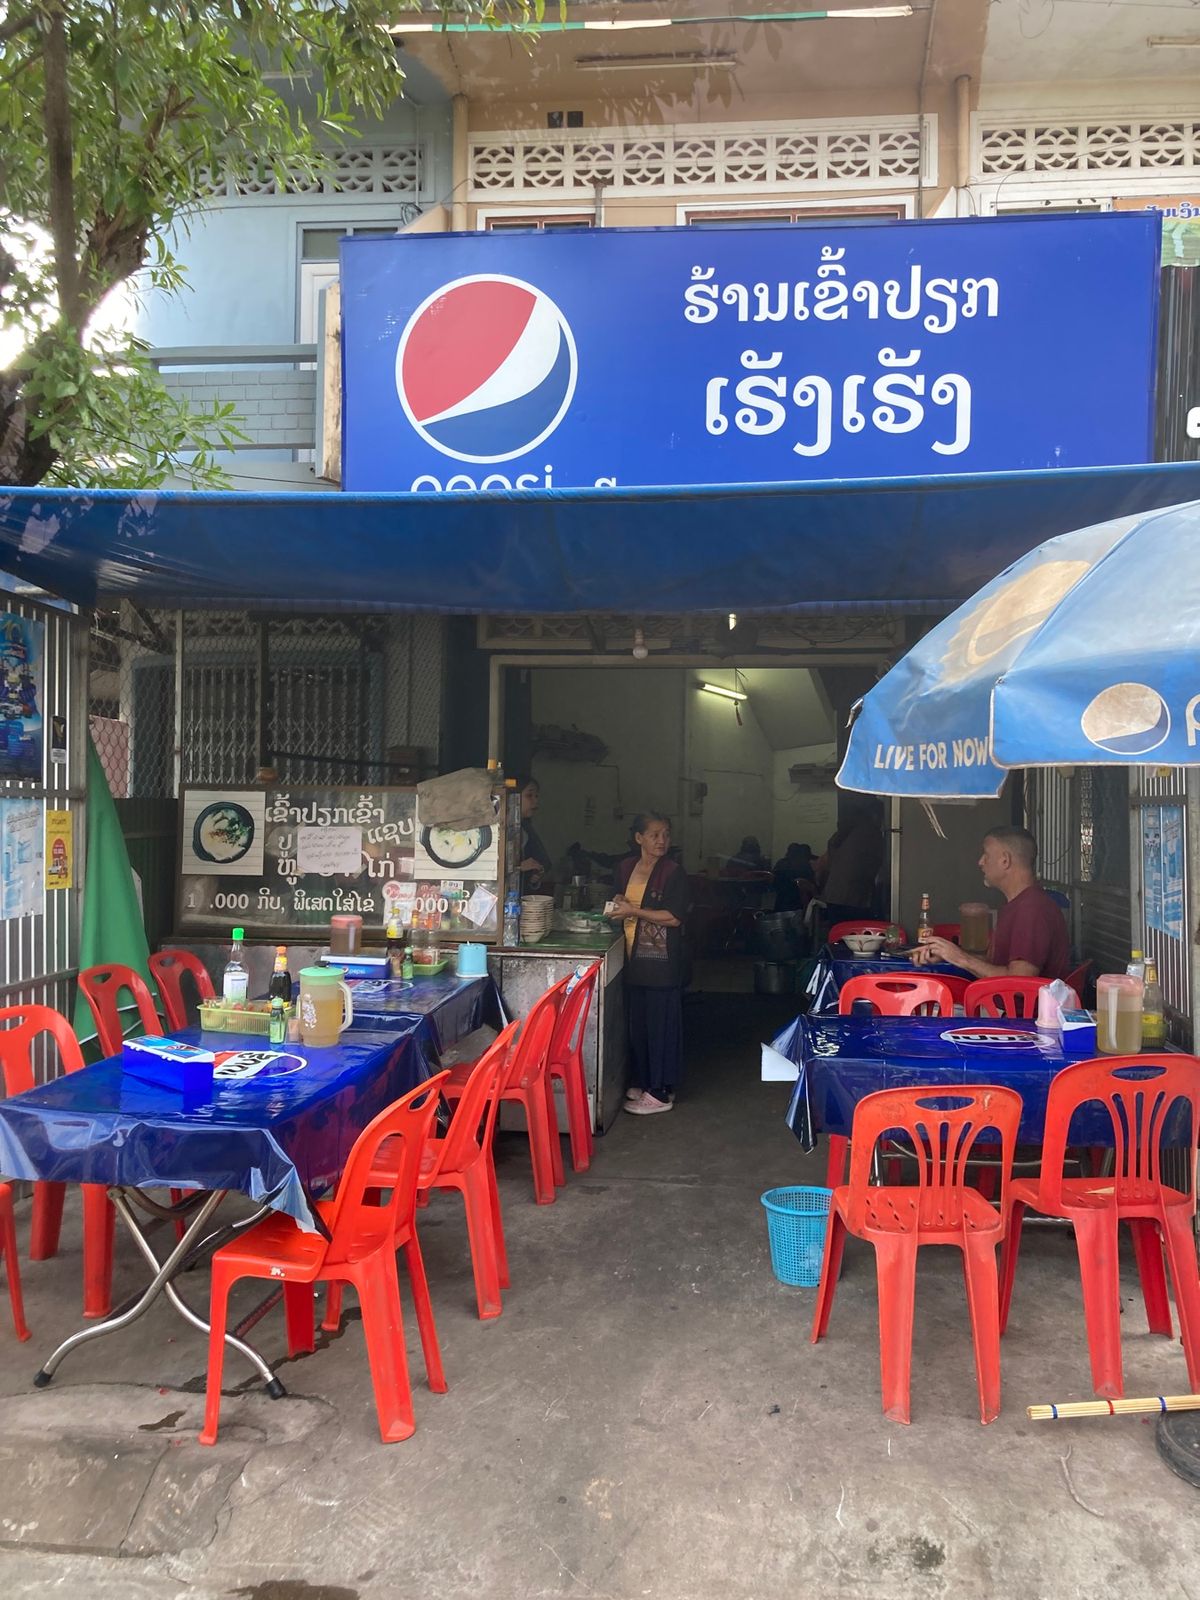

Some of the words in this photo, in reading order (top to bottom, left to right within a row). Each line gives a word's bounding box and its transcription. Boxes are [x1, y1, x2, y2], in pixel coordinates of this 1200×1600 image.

[684, 246, 998, 334] ຮ້ານເຂົ້າປຽກ
[706, 347, 972, 457] ເຮັງເຮັງ
[874, 744, 915, 771] LIVE
[919, 742, 947, 771] FOR
[952, 736, 989, 768] NOW
